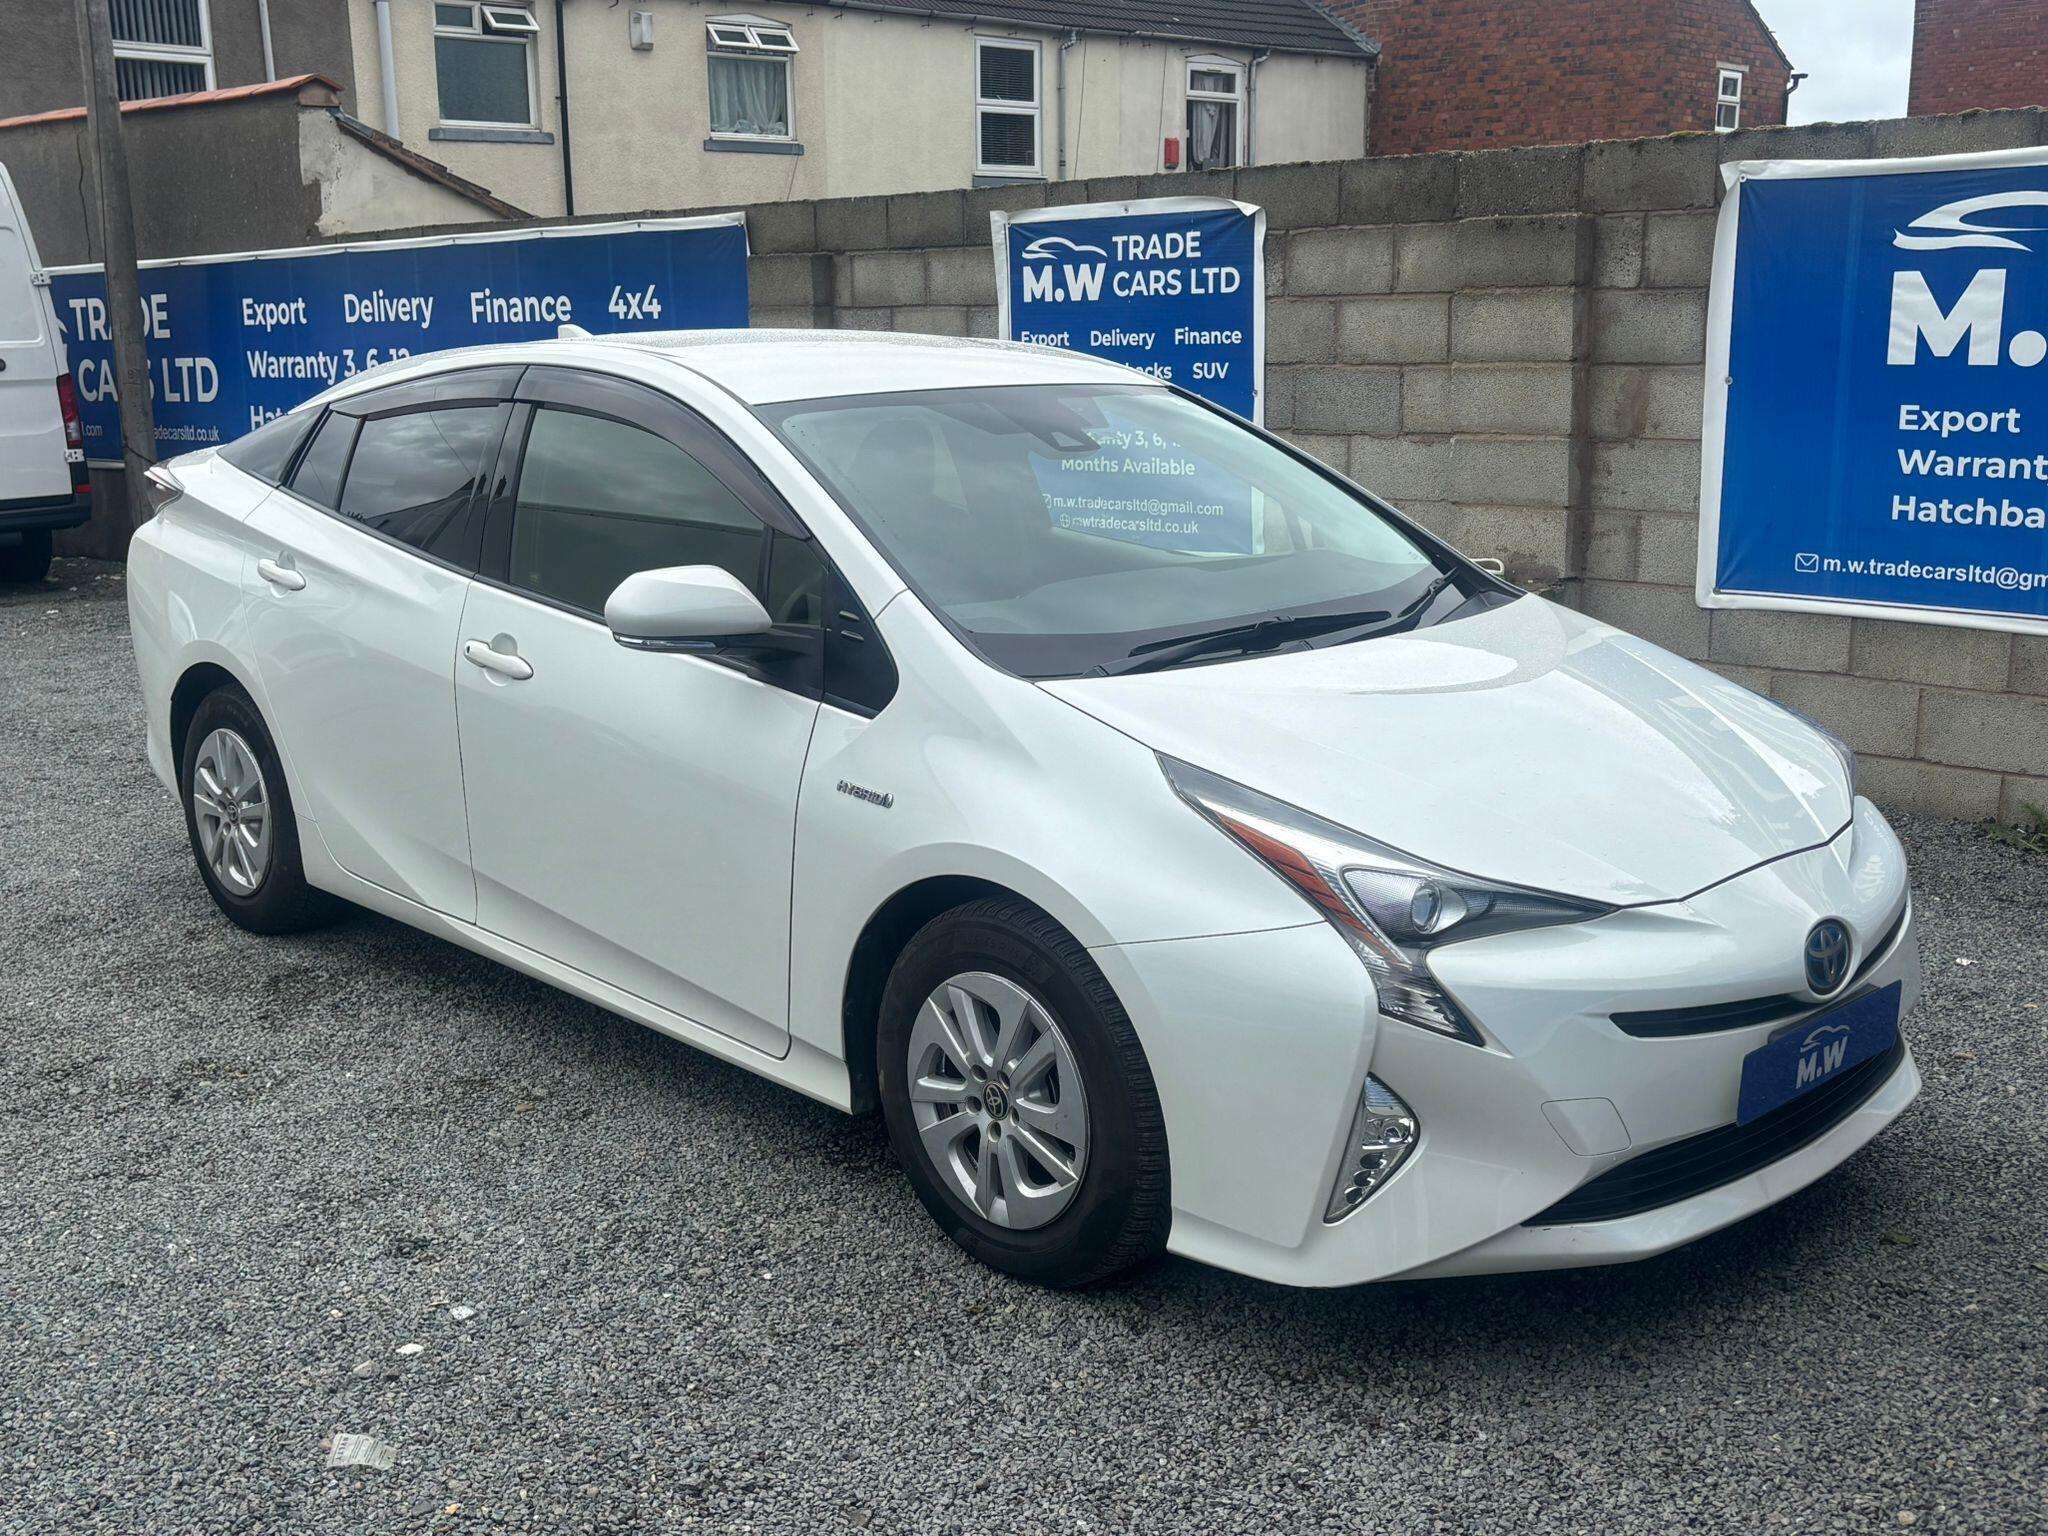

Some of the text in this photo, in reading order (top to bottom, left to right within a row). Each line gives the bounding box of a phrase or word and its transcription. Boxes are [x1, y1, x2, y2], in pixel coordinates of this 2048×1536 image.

[1112, 231, 1202, 261] TRADE
[1022, 262, 1106, 303] M.W
[1112, 266, 1241, 297] CARS LTD
[69, 293, 171, 342] TRE
[242, 285, 661, 332] Export Delivery Finance 4x4
[1887, 269, 2048, 367] M.
[1021, 326, 1243, 350] Export Delivery Finance
[78, 356, 219, 403] CA LTD
[247, 350, 338, 386] Warranty
[1192, 362, 1229, 380] SUV
[1899, 404, 2021, 438] Export
[1135, 430, 1149, 449] 3,
[1061, 457, 1195, 475] Months Available
[1897, 448, 2048, 487] Warrant
[1053, 497, 1224, 516] m.w.tradecarsltd@gmail.com
[1795, 1035, 1848, 1090] M.W
